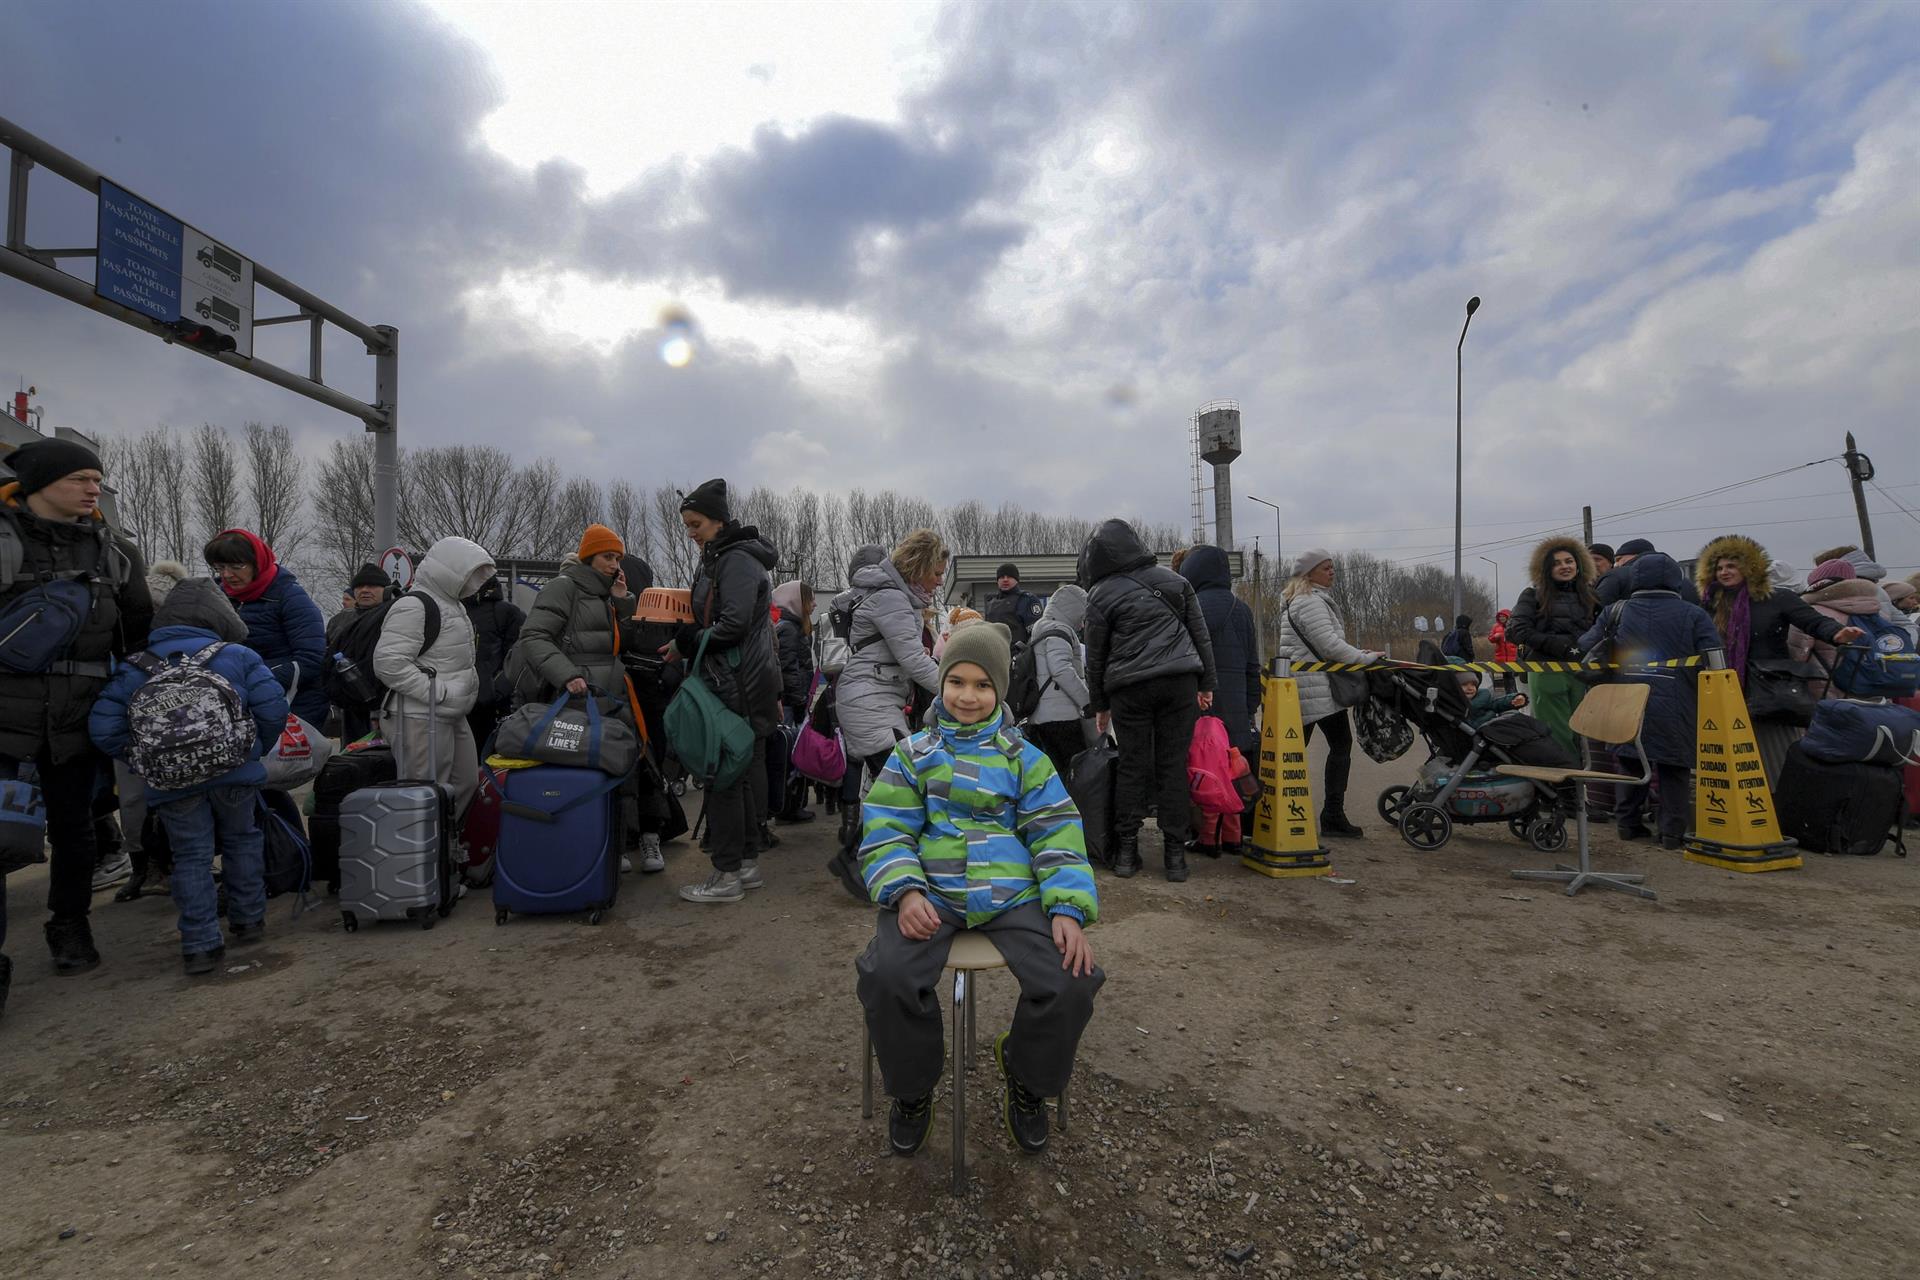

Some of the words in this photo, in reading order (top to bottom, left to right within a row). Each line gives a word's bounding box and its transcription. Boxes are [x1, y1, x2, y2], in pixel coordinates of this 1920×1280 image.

[128, 201, 159, 224] TOATE
[105, 200, 179, 246] PASAPOARTELE
[134, 227, 153, 242] ALL
[115, 228, 168, 260] PASSPORTS
[126, 257, 158, 279] TOATE
[103, 258, 177, 299] PASAPOARTELE
[132, 283, 151, 298] ALL
[113, 285, 167, 314] PASSPORTS
[1700, 743, 1724, 755] CAUTION
[1733, 742, 1755, 754] CAUTION
[1282, 752, 1304, 763] CAUTION
[1700, 761, 1727, 773] CUIDADO
[1735, 760, 1760, 773] CUIDADO
[1282, 769, 1306, 780] CUIDADO
[1700, 777, 1730, 790] ATTENTION
[1738, 777, 1765, 790] ATTENTION
[1282, 786, 1309, 797] ATTENTION
